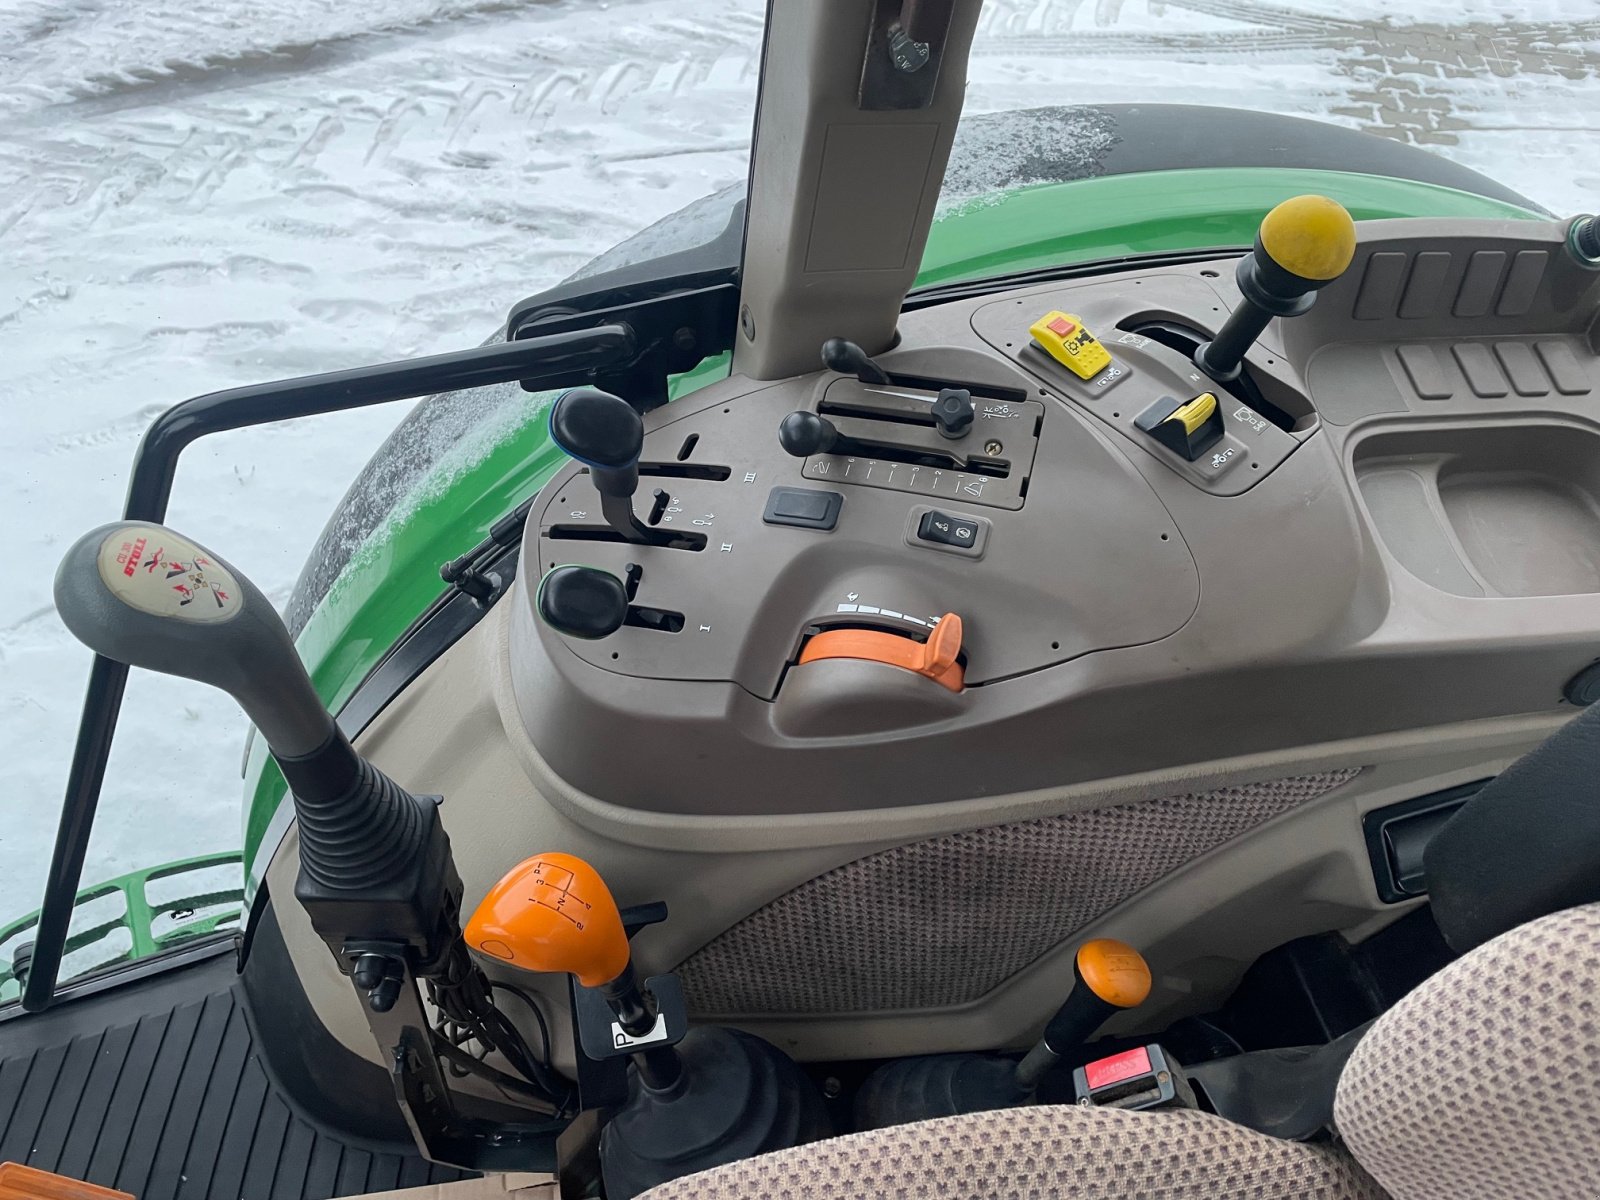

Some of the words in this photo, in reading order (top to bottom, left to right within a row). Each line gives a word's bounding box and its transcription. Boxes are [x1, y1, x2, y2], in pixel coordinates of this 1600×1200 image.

[1253, 421, 1266, 431] 540
[123, 537, 147, 577] STOLL
[557, 897, 566, 906] N
[585, 902, 592, 910] 4
[576, 921, 584, 931] 2
[615, 1033, 634, 1047] P
